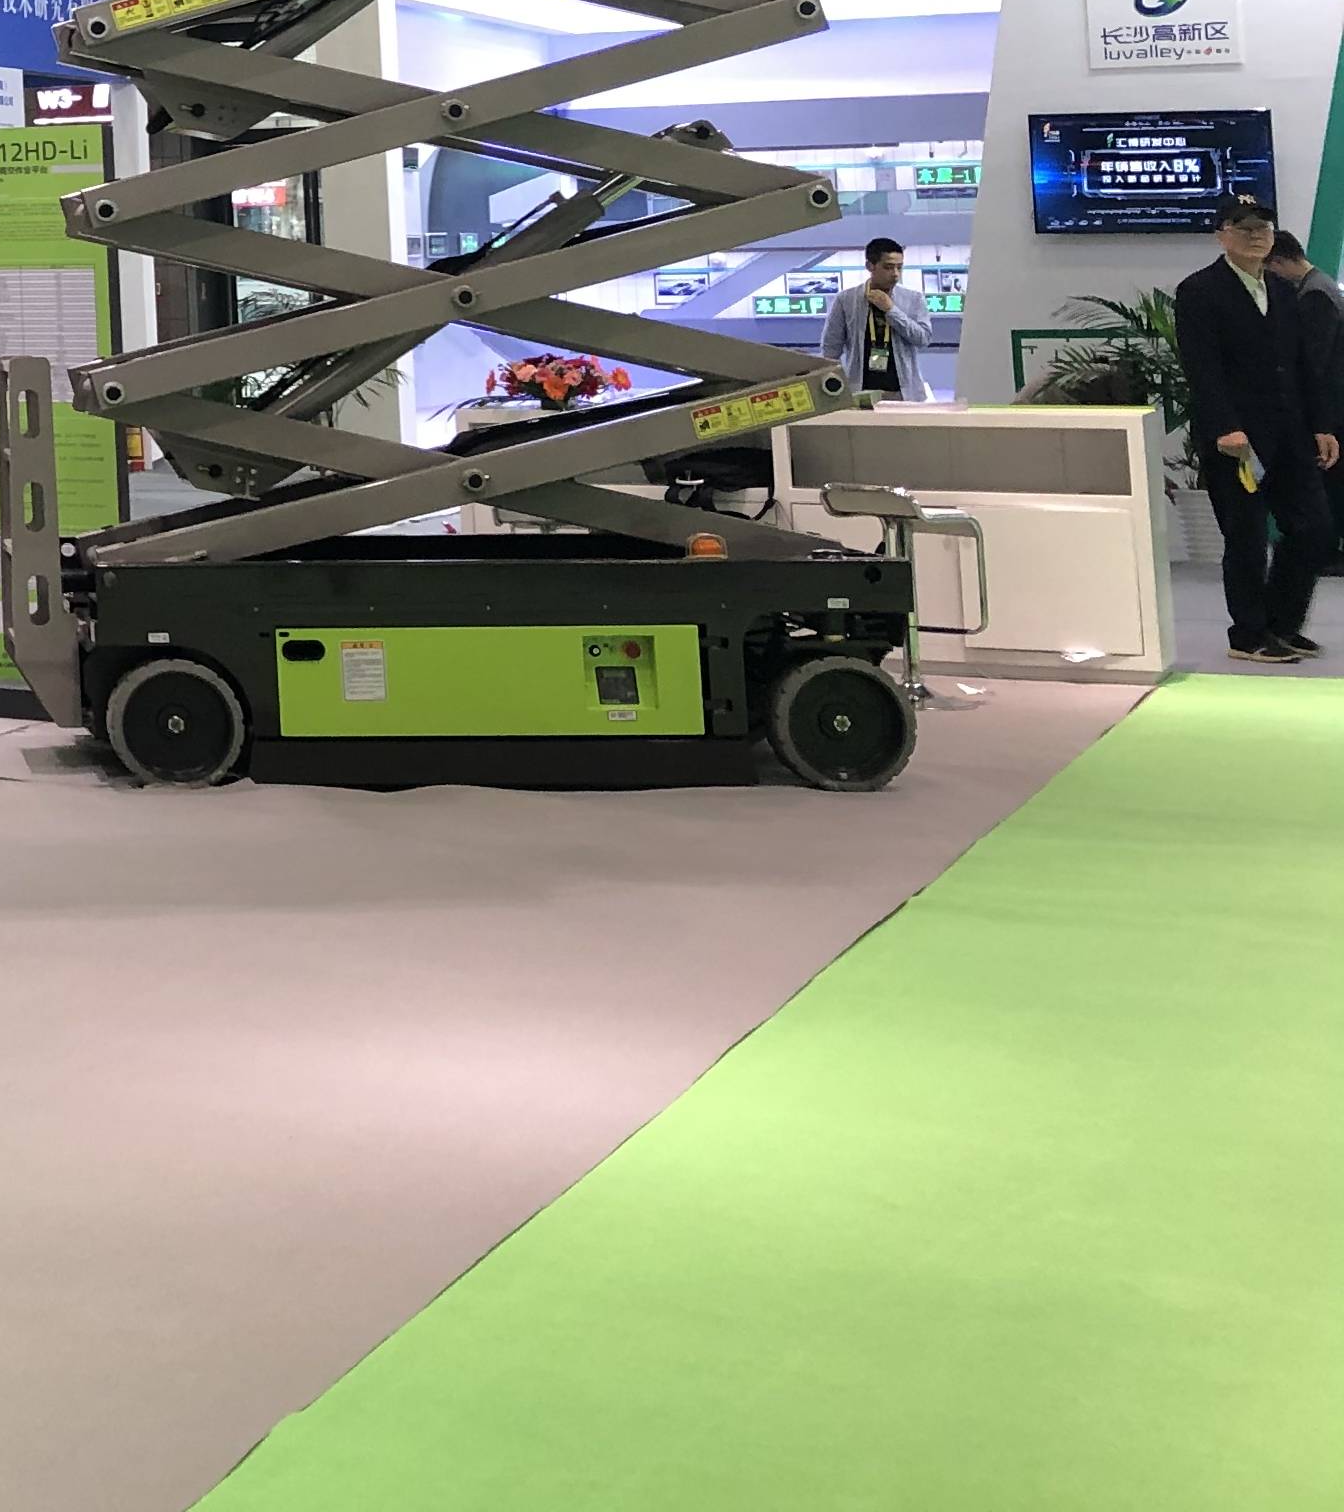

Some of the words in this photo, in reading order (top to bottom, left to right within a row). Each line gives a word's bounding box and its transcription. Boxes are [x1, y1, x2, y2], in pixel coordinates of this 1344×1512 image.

[1100, 21, 1229, 45] 长沙高新区
[1104, 45, 1184, 61] luvalley
